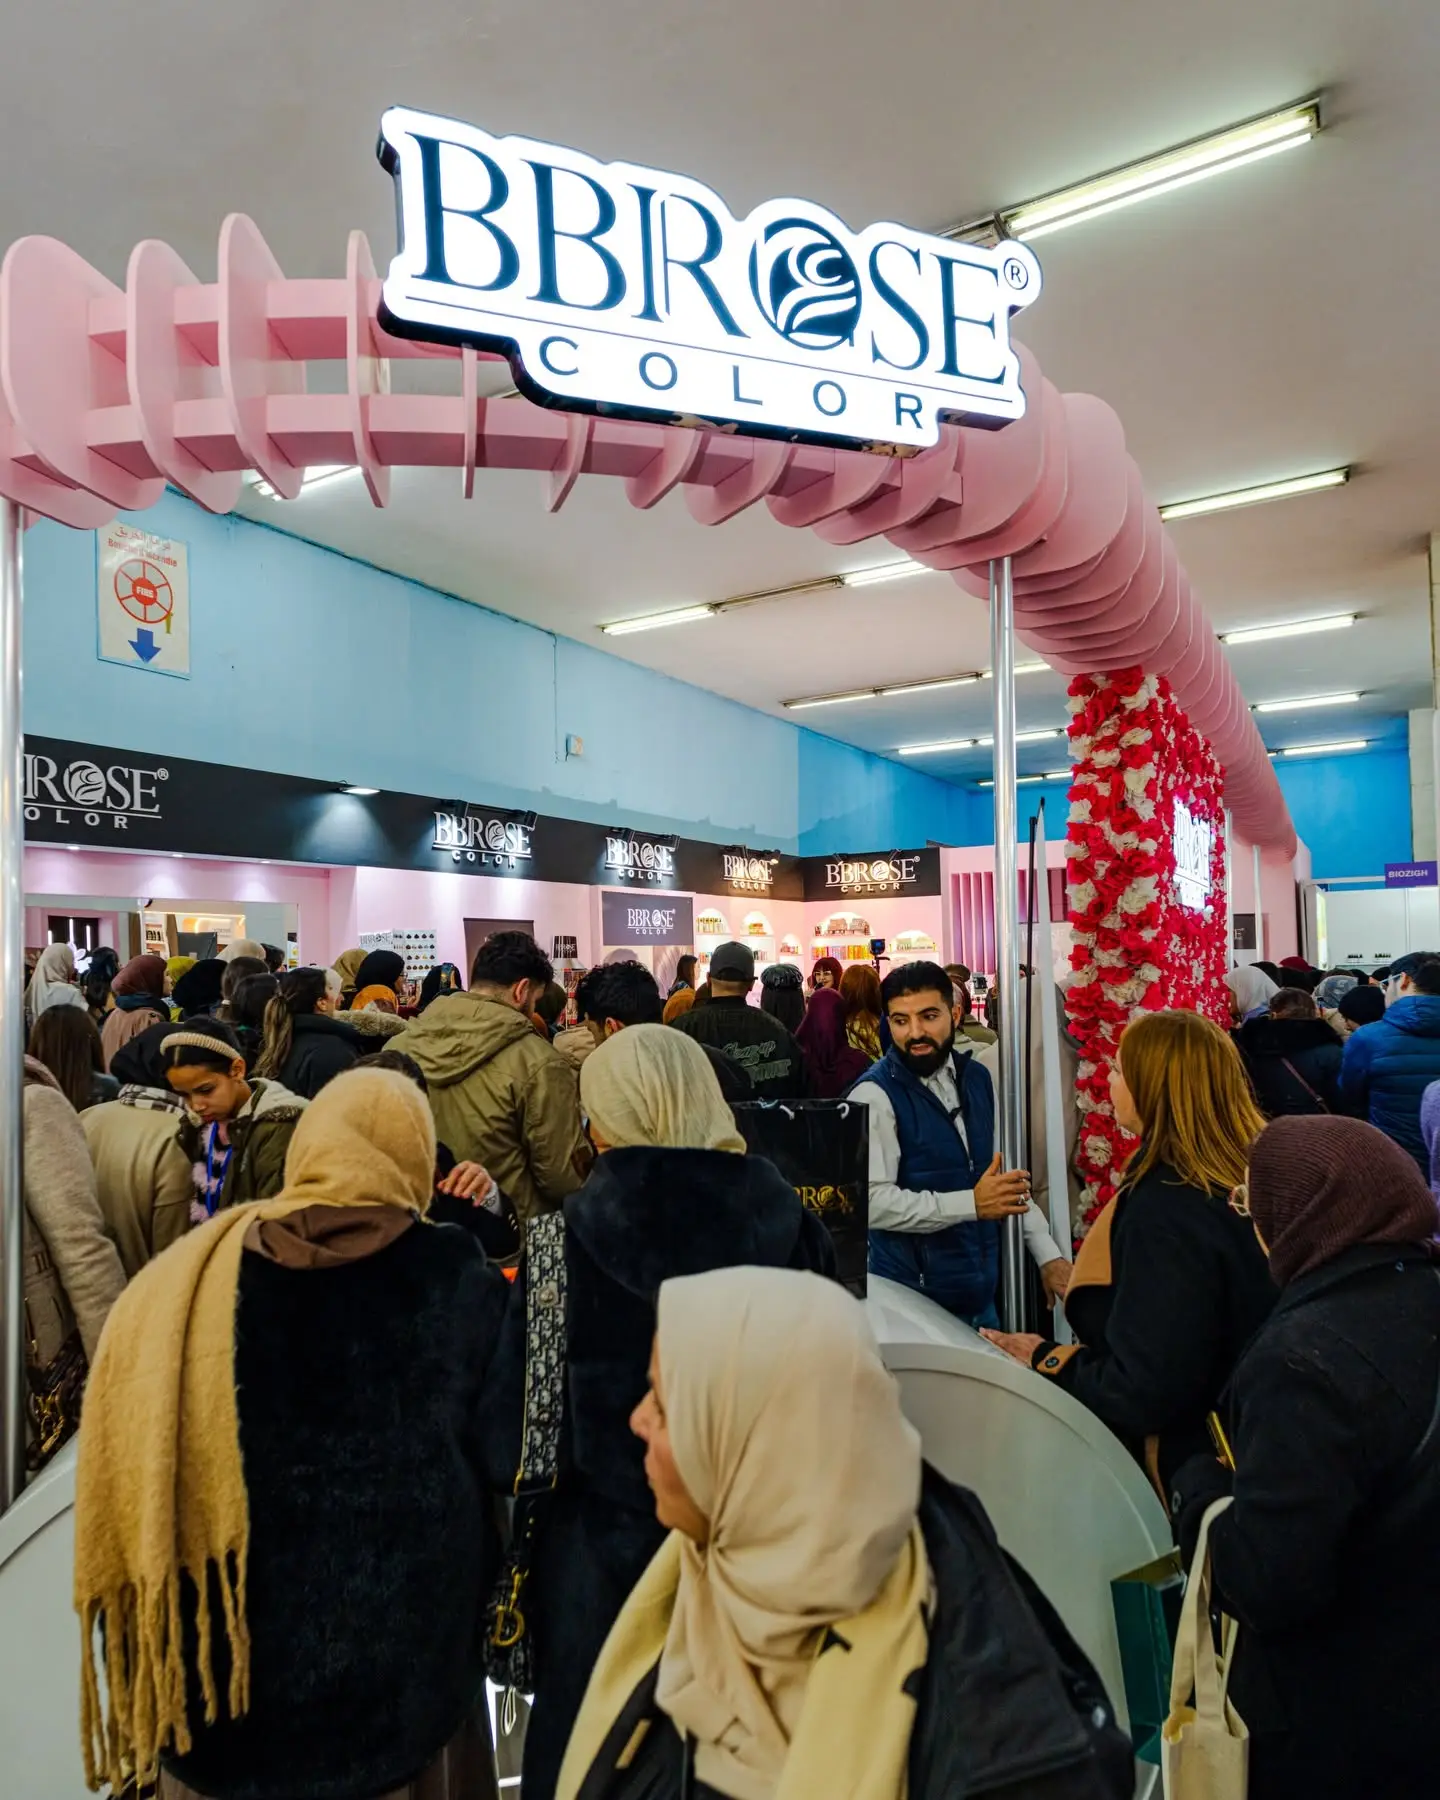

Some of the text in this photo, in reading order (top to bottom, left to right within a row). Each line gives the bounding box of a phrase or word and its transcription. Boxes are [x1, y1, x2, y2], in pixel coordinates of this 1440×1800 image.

[539, 335, 924, 430] COLOR
[451, 850, 517, 867] COLOR
[618, 869, 663, 881] COLOR
[1388, 869, 1428, 878] BIOZIGH
[841, 882, 900, 893] COLOR
